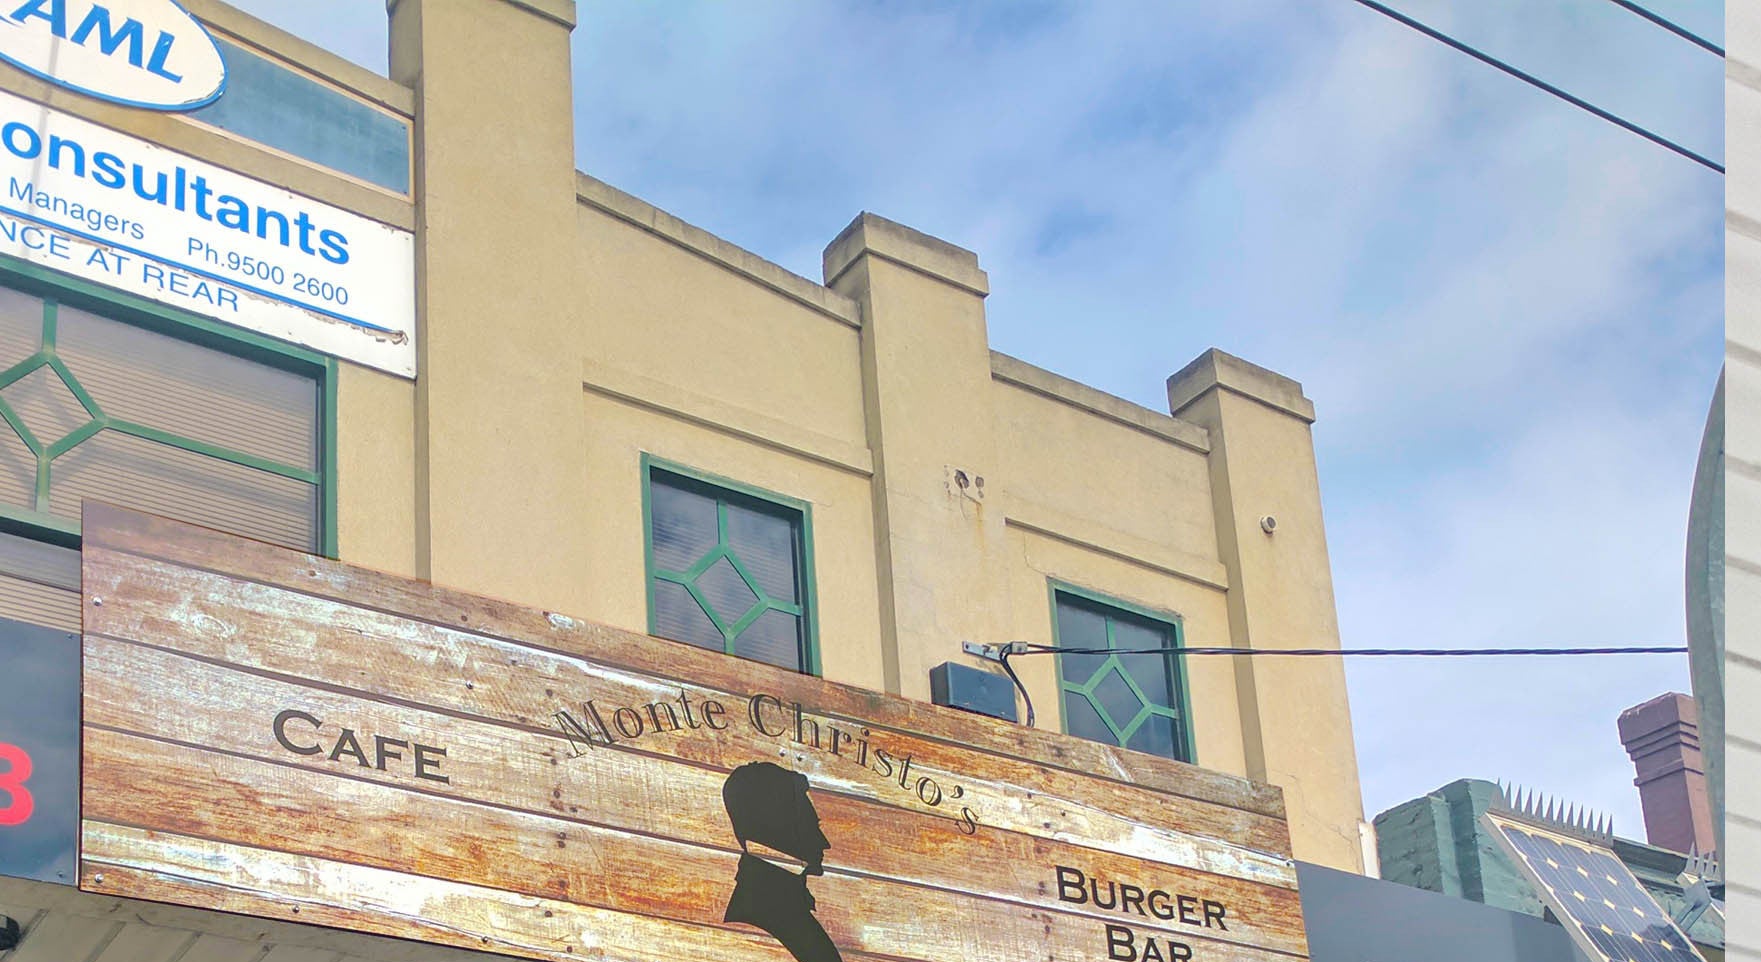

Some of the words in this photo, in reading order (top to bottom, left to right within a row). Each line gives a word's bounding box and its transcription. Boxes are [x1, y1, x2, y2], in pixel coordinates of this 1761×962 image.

[10, 0, 183, 84] AML
[2, 122, 350, 265] onsultants
[10, 177, 144, 240] Managers
[293, 273, 348, 306] 2600
[86, 248, 130, 275] AT
[143, 264, 238, 312] REAR
[273, 709, 450, 785] CAFE
[552, 686, 729, 759] Monte
[748, 694, 980, 836] Christo's
[1056, 866, 1229, 932] BURGER
